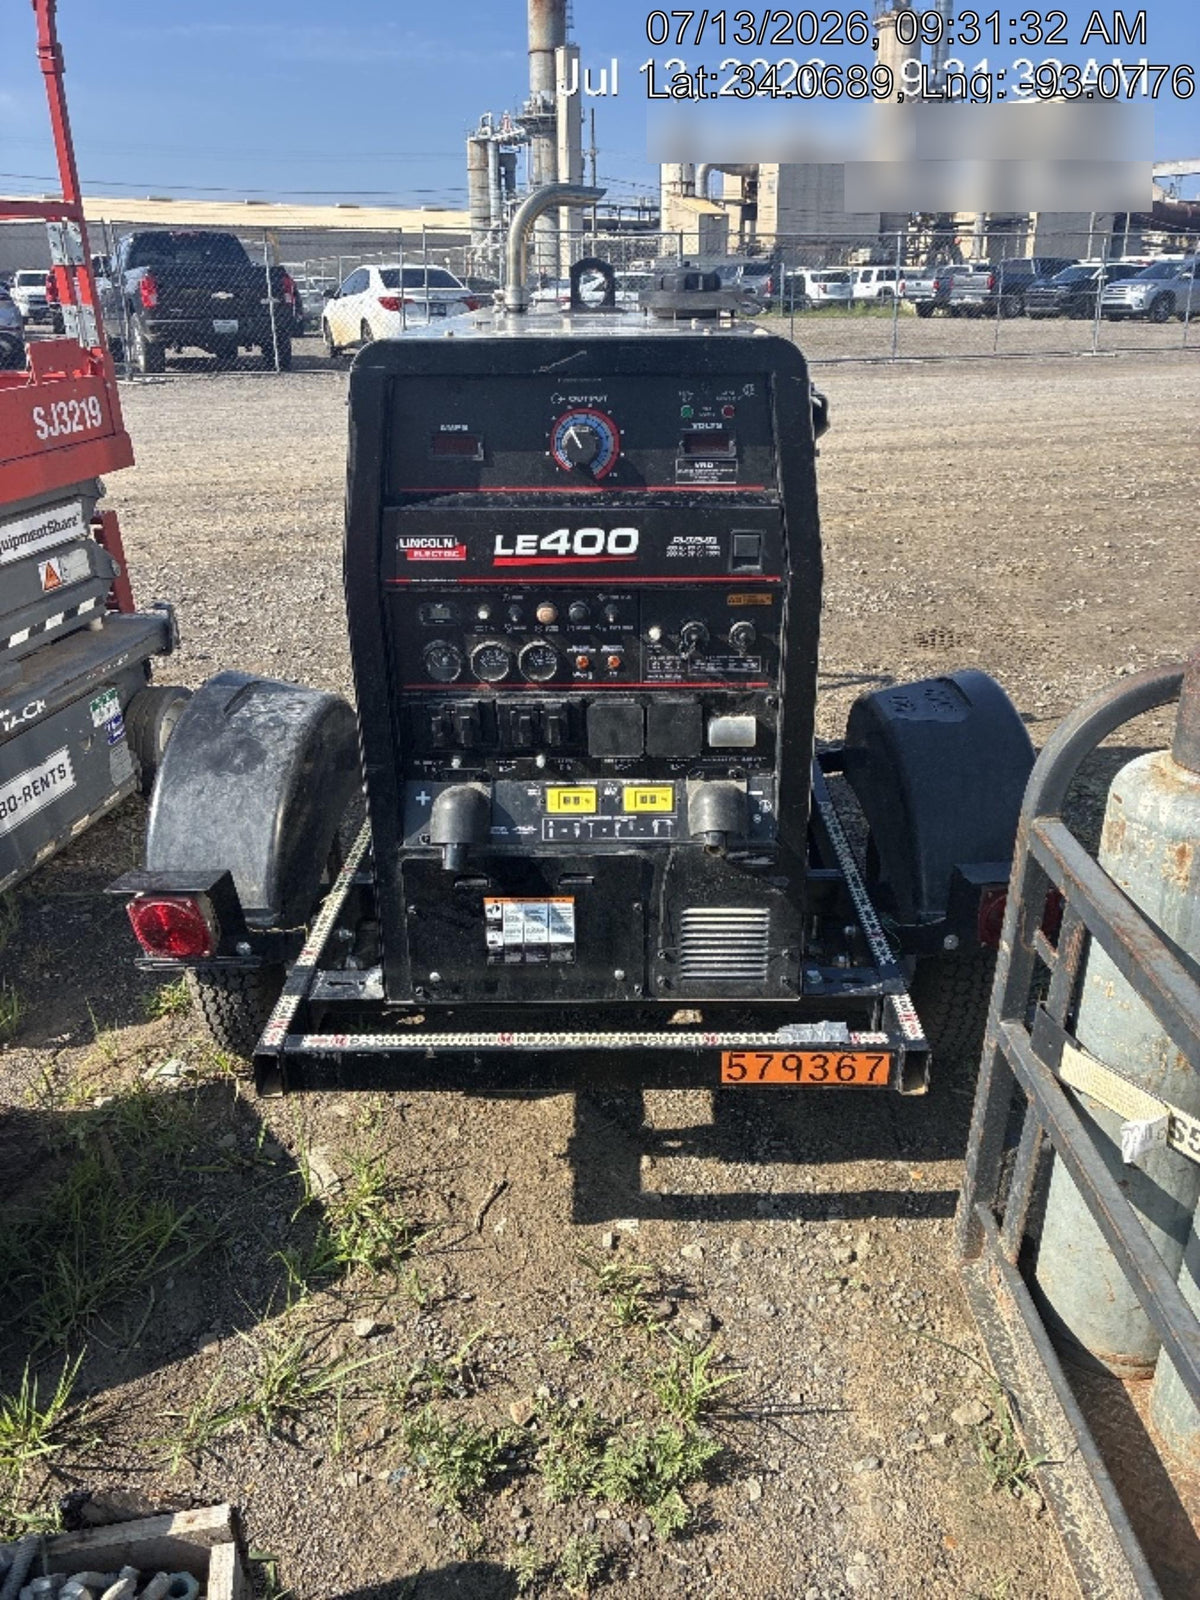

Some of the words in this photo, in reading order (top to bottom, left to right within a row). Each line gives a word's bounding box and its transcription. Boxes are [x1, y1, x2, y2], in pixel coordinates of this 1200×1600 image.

[33, 396, 102, 440] SJ3219
[400, 537, 454, 548] LINCOLN
[494, 528, 639, 555] LE400
[726, 1052, 885, 1081] 579367
